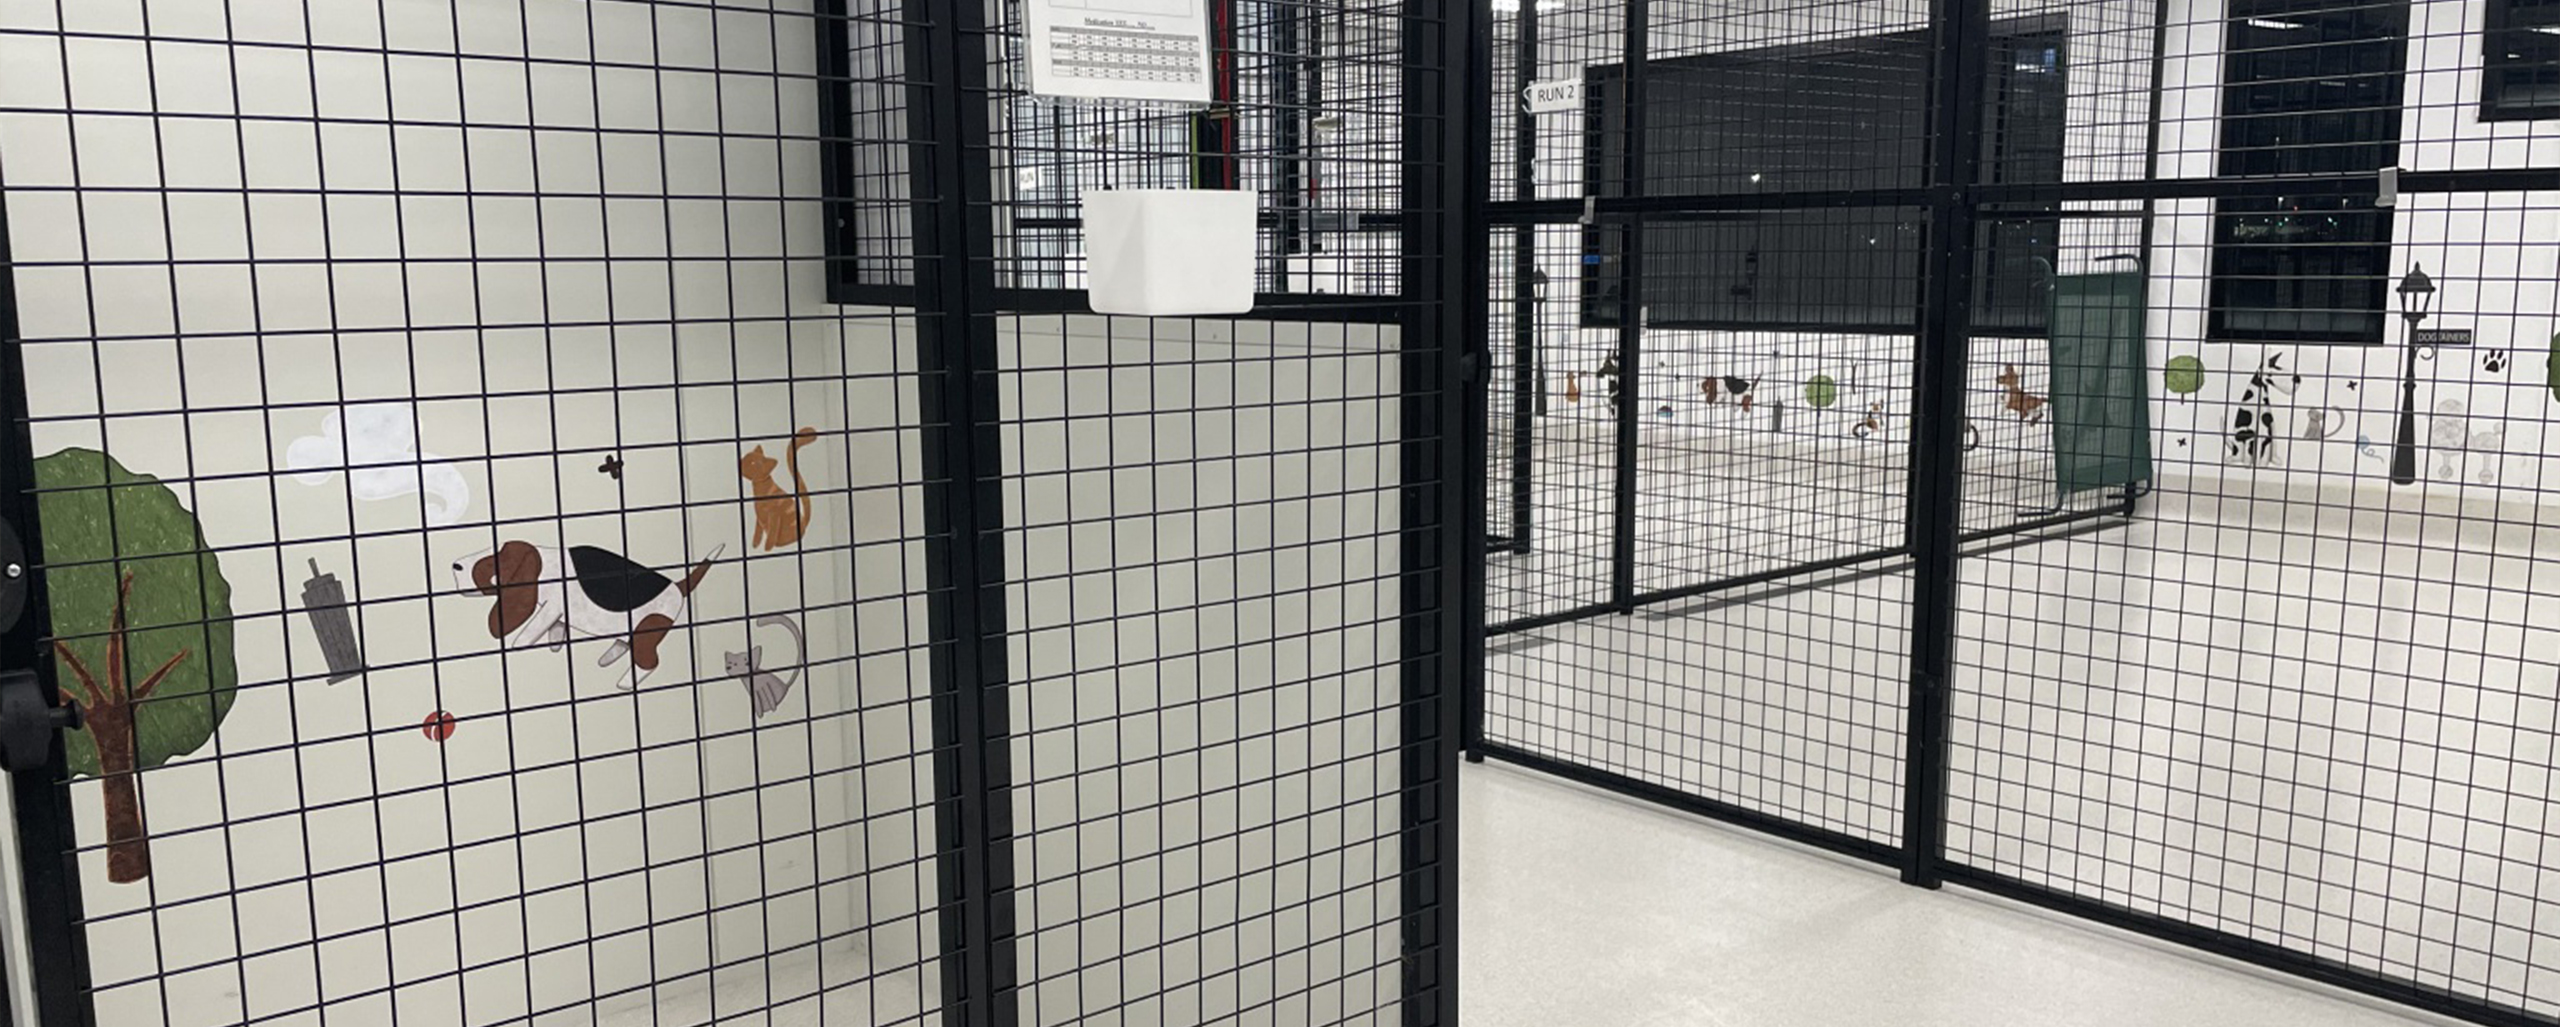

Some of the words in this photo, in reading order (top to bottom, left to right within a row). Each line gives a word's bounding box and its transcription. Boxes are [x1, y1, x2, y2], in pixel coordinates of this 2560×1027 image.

[1538, 86, 1564, 103] RUN
[1567, 85, 1575, 99] 2
[2417, 332, 2470, 342] DOGAINERS
